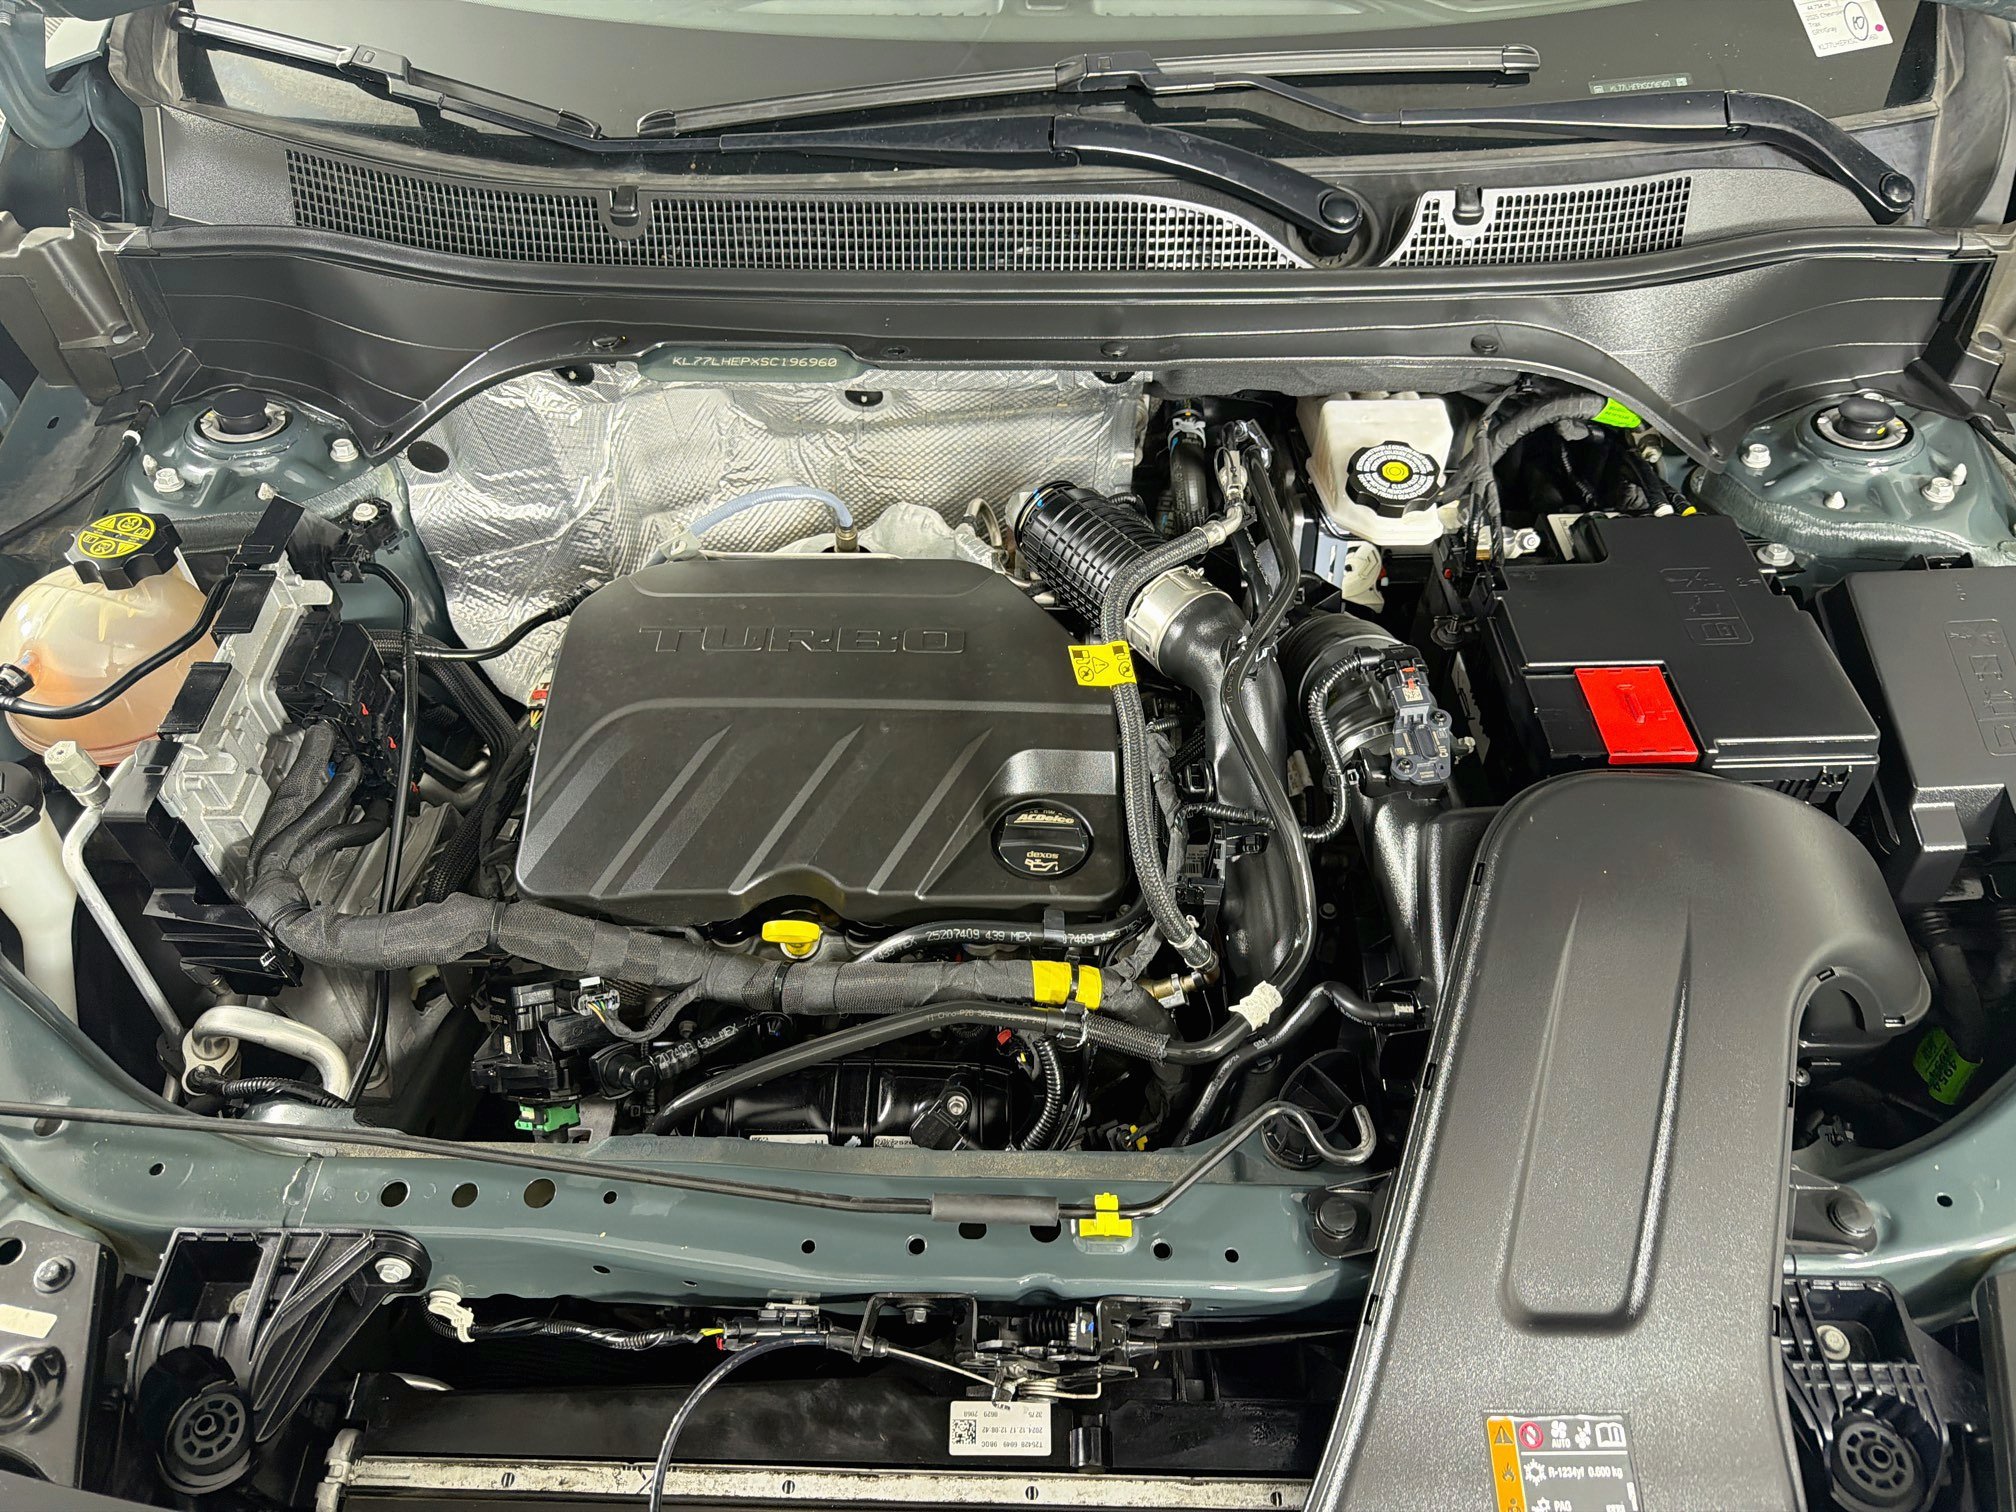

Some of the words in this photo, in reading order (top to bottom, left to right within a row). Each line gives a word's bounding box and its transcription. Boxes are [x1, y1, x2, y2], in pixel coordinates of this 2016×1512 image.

[672, 356, 838, 367] KL77LHEPXSC196960
[639, 626, 966, 654] TURBO
[1014, 813, 1075, 824] ACDelco
[1026, 850, 1060, 859] dexos
[1125, 917, 1143, 933] MEX
[925, 928, 980, 941] 25207409
[985, 930, 1005, 941] 439
[1010, 931, 1032, 942] MEX
[1551, 1438, 1571, 1449] AUTO
[1547, 1466, 1585, 1480] R-1234yf
[1611, 1466, 1624, 1480] kg
